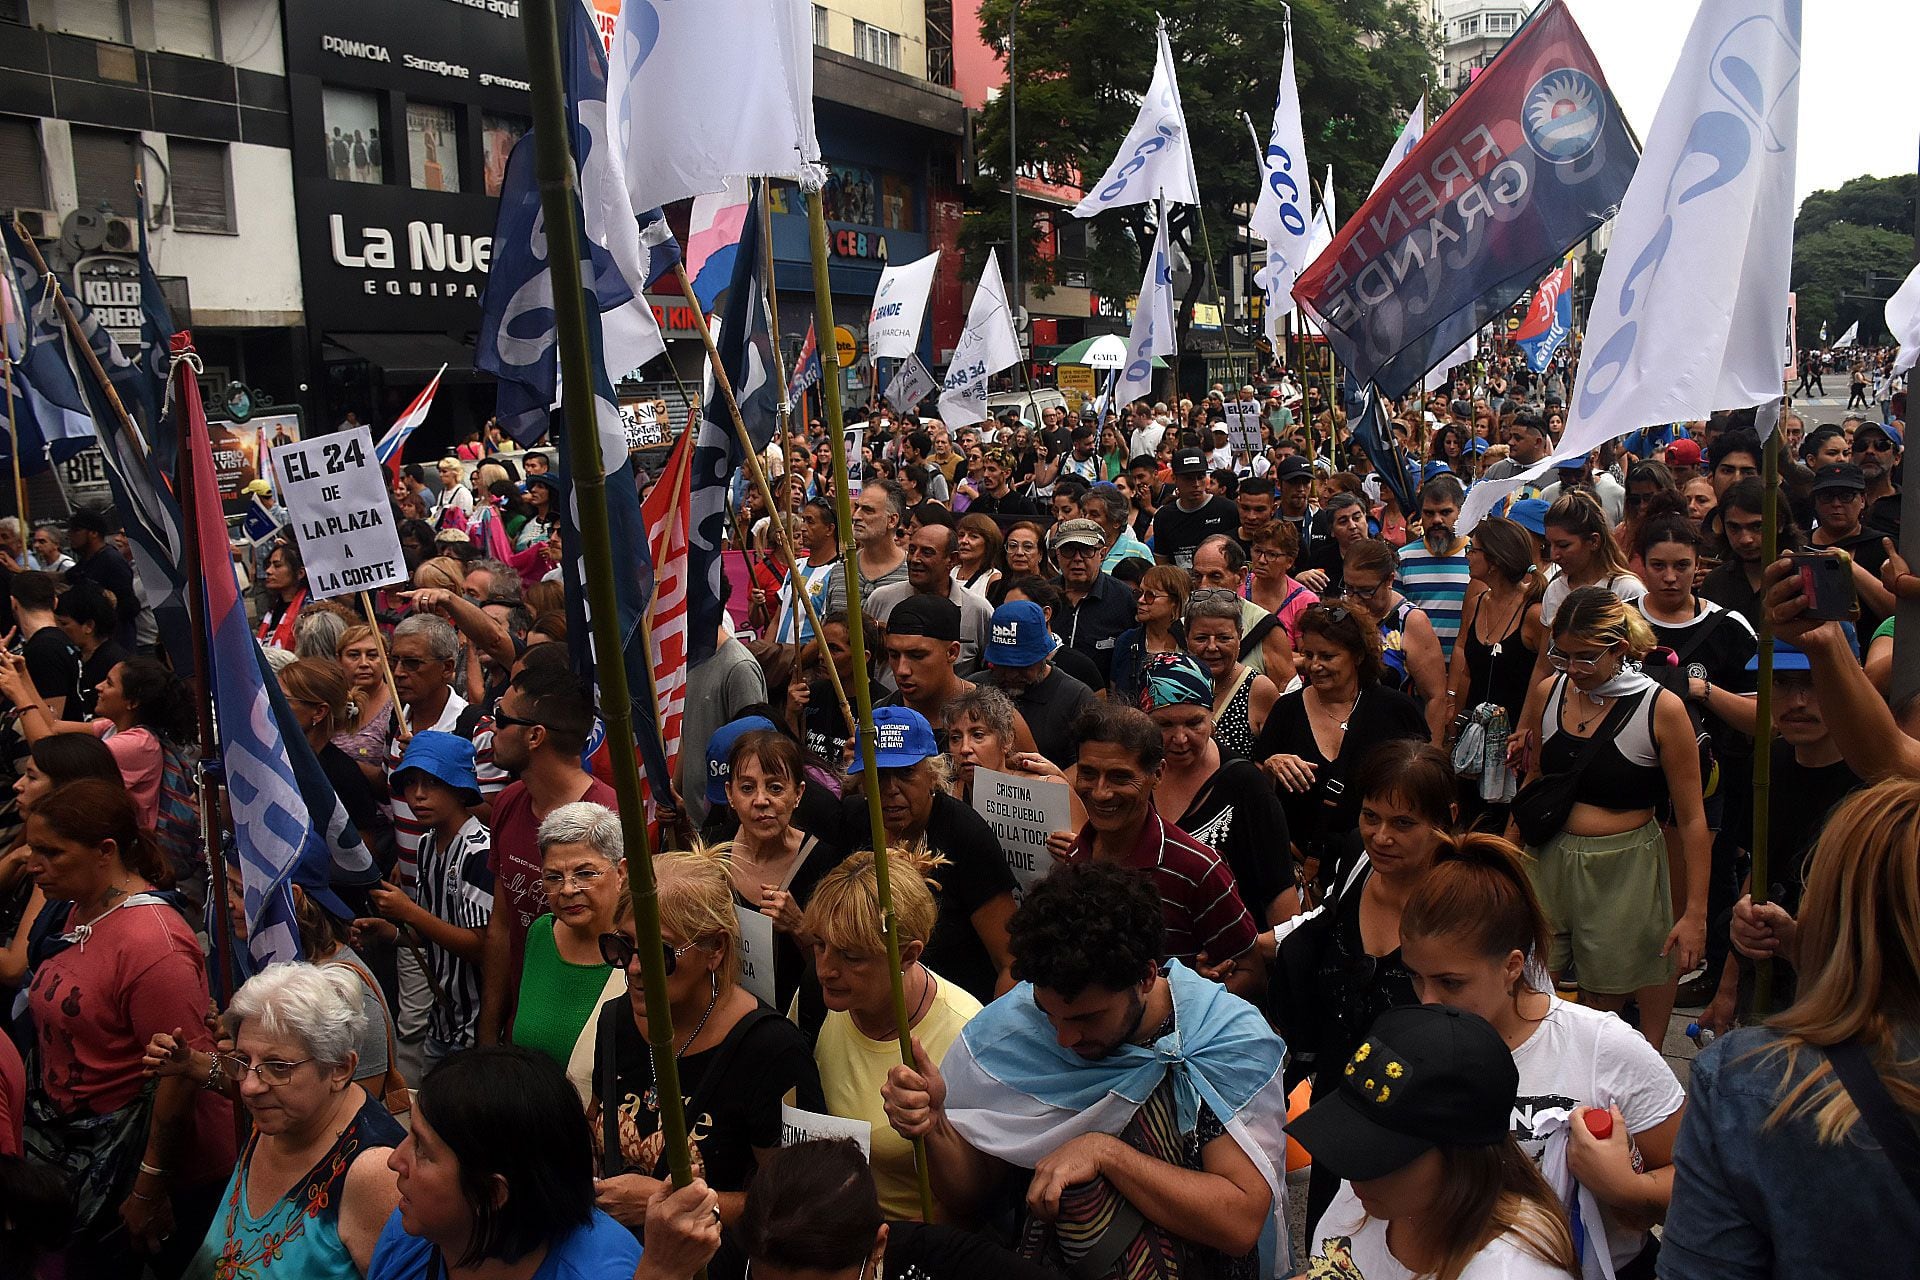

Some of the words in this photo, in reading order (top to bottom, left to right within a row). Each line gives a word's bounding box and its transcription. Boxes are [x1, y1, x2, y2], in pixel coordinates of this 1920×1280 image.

[322, 35, 391, 63] PRIMICIA
[329, 214, 396, 268] La
[836, 230, 888, 261] CEBRA
[364, 280, 478, 297] EQUIPA
[881, 328, 911, 338] MARCHA
[1228, 405, 1240, 415] EL
[1242, 405, 1255, 415] 24
[67, 452, 103, 484] BIE
[282, 451, 320, 483] EL
[323, 438, 366, 475] 24
[321, 484, 342, 502] DE
[302, 520, 327, 541] LA
[326, 508, 383, 536] PLAZA
[344, 544, 354, 558] A
[318, 572, 341, 592] LA
[341, 560, 396, 587] CORTE
[996, 783, 1032, 801] CRISTINA
[986, 800, 996, 813] ES
[996, 803, 1011, 818] DEL
[1012, 806, 1045, 824] PUEBLO
[1006, 825, 1020, 842] LA
